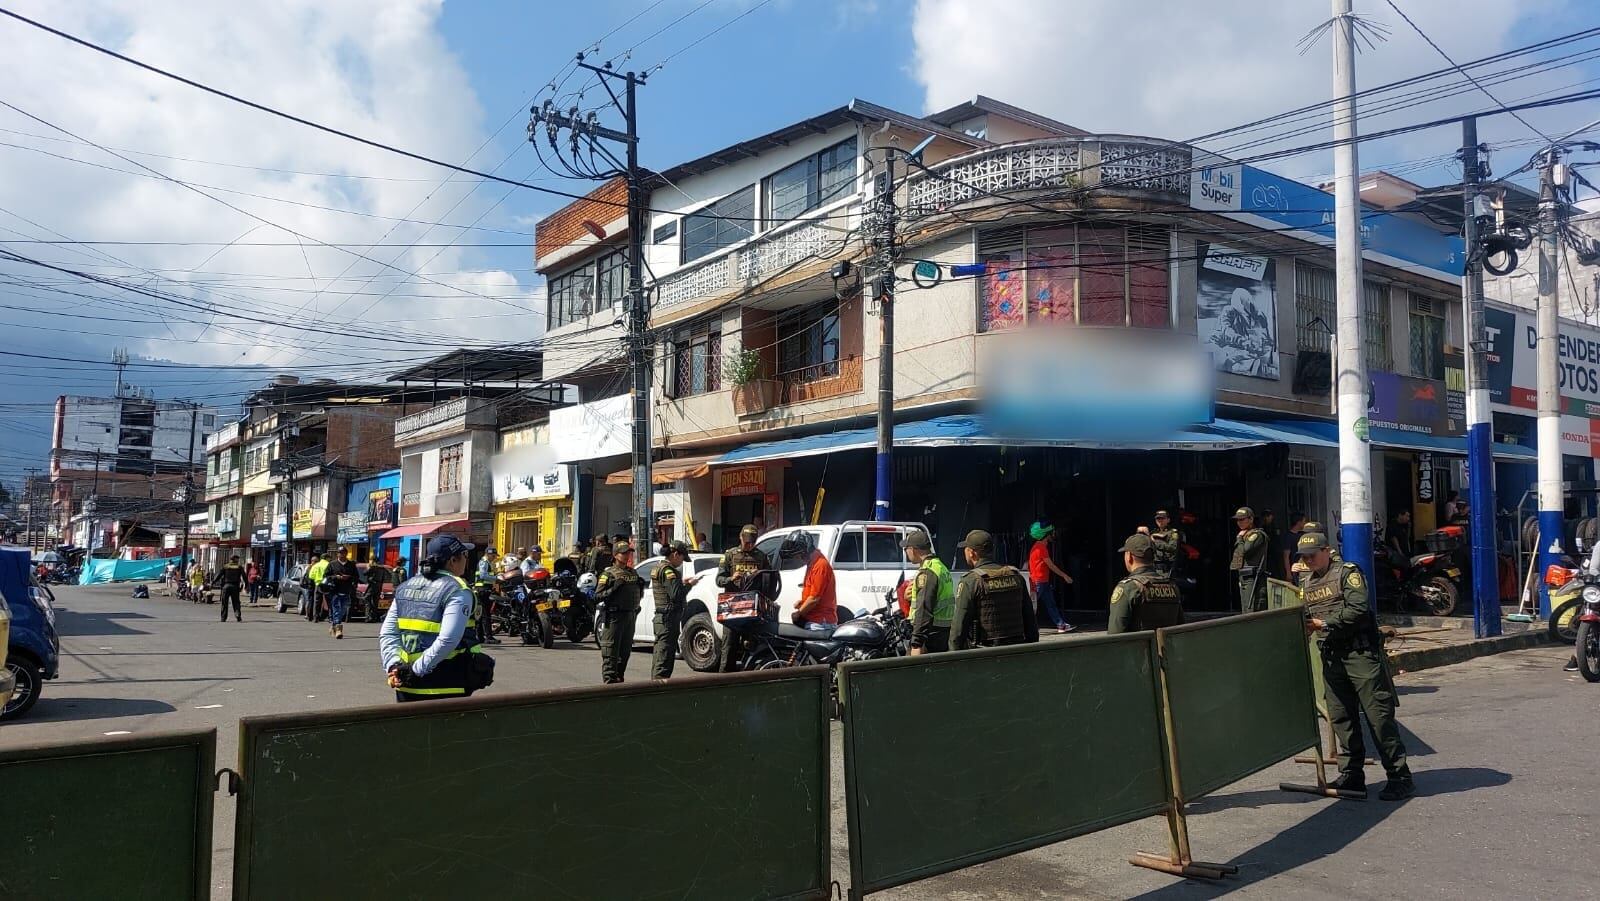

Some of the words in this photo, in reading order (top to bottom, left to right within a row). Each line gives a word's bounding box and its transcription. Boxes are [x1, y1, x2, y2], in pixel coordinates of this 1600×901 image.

[1201, 183, 1233, 204] Super
[1559, 362, 1598, 394] OTOS
[1368, 420, 1399, 430] EPUESTOS
[1419, 452, 1432, 499] CAJAS
[988, 577, 1018, 589] POLICIA
[1150, 587, 1177, 598] POLICIA
